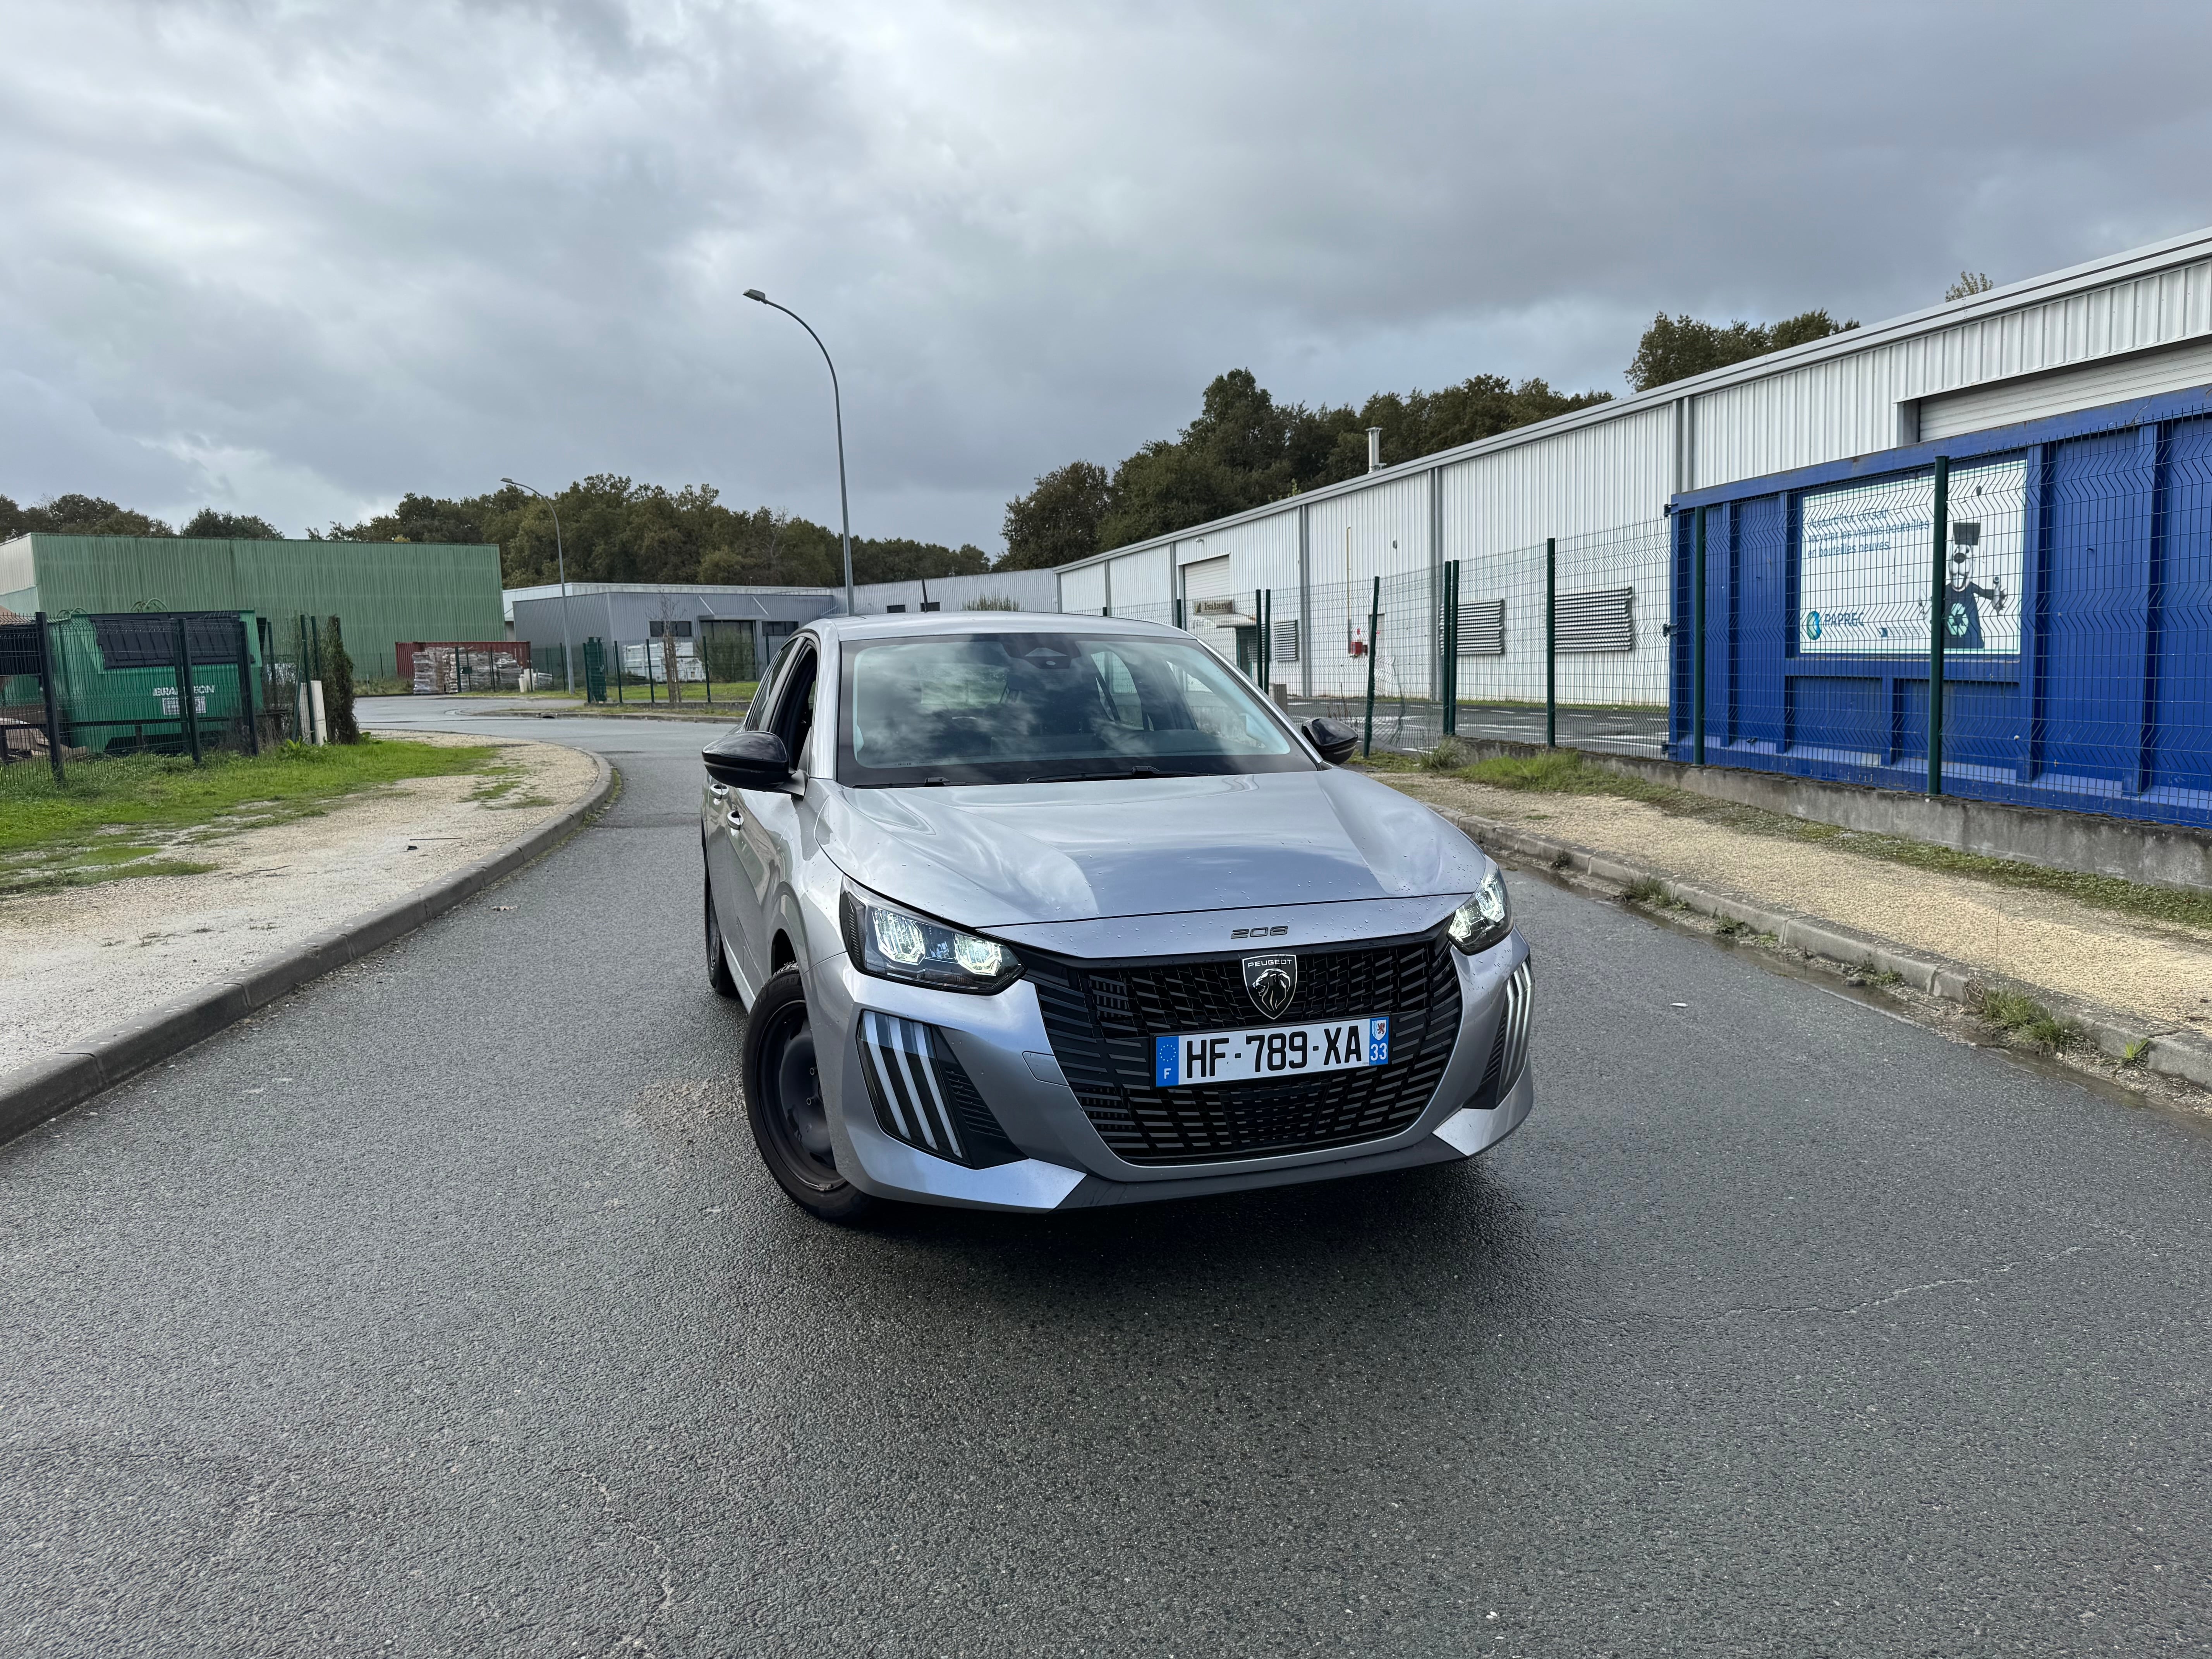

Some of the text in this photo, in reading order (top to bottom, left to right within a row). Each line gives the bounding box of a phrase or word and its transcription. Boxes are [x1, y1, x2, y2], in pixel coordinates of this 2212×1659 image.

[1859, 513, 1869, 522] on
[1872, 508, 1887, 519] sait
[1809, 519, 1929, 544] recycler les vieilles bouteilles
[1819, 543, 1856, 556] bouteilles
[1825, 612, 1864, 627] PAPREC
[1231, 926, 1288, 939] 208
[1248, 959, 1292, 968] PEUGEOT
[1187, 1025, 1362, 1078] HF-789-XA
[1370, 1042, 1387, 1061] 33
[1164, 1068, 1171, 1079] F
